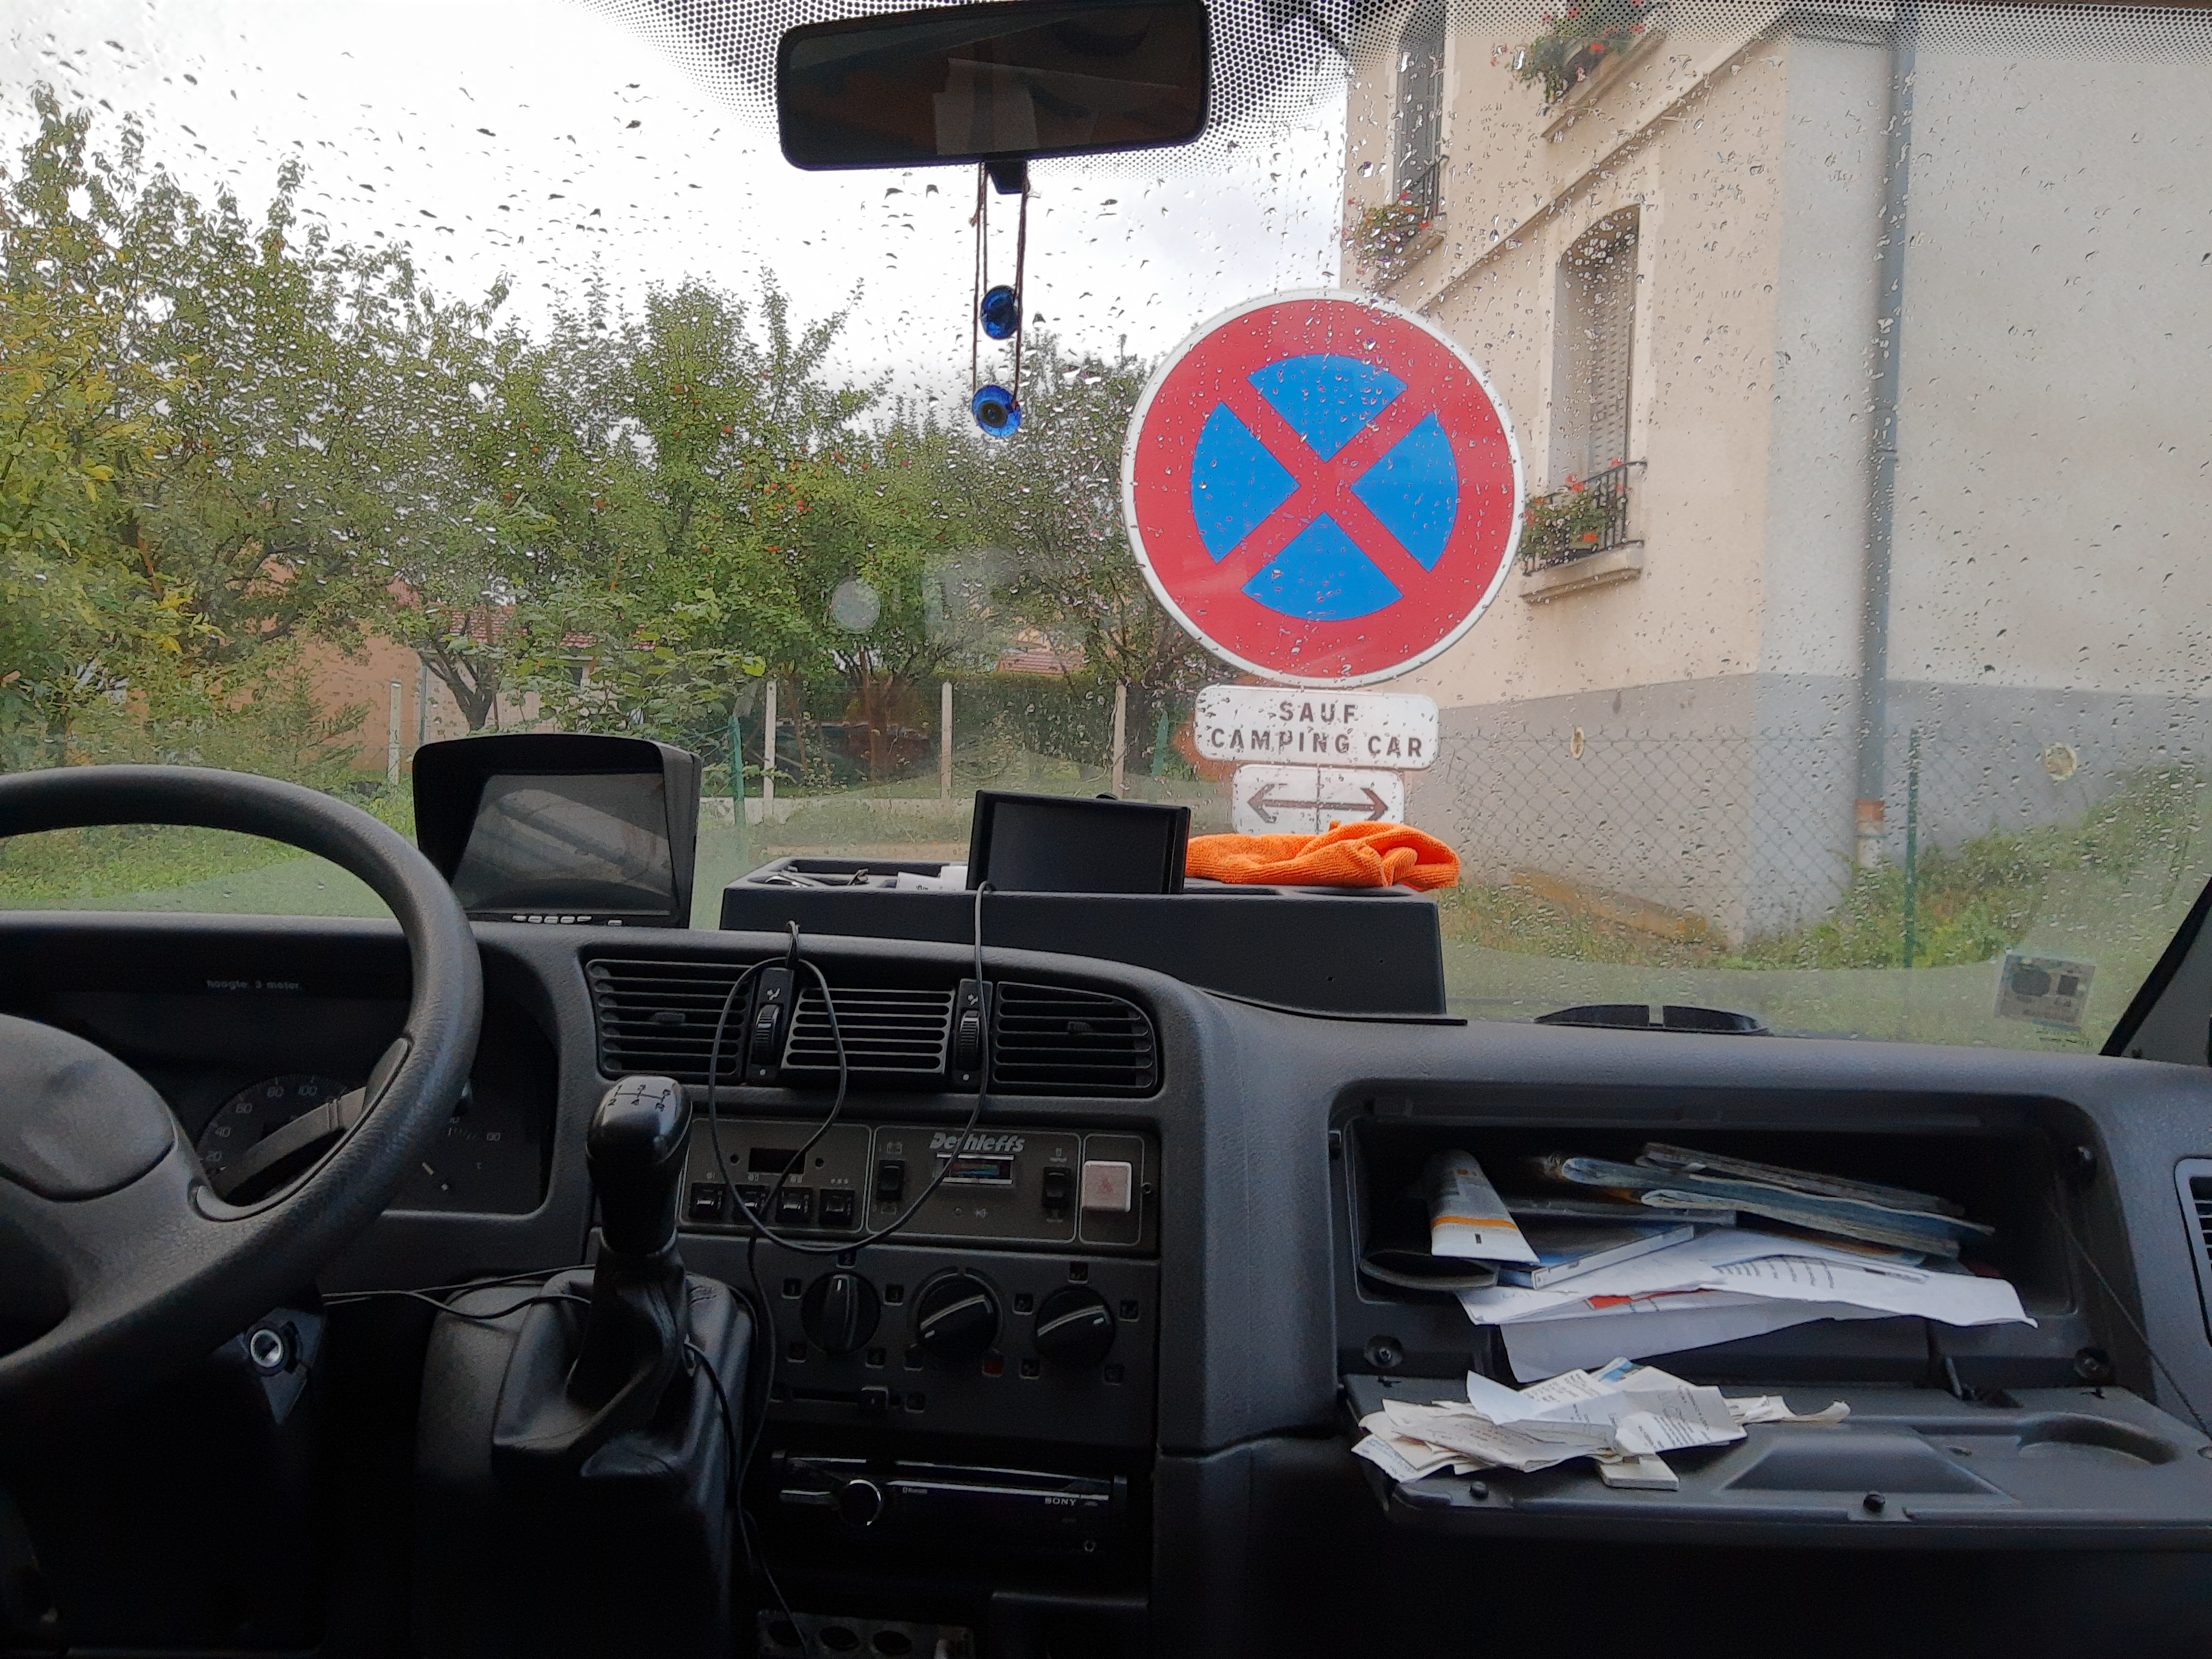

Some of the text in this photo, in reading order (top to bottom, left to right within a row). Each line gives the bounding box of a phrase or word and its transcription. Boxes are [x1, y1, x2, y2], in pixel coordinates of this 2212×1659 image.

[1279, 702, 1358, 724] SAUF
[1210, 728, 1422, 758] CAMPING CAR
[298, 1085, 318, 1096] 100
[215, 1126, 232, 1138] 40
[205, 1150, 222, 1162] 20
[1044, 1497, 1076, 1506] SONY
